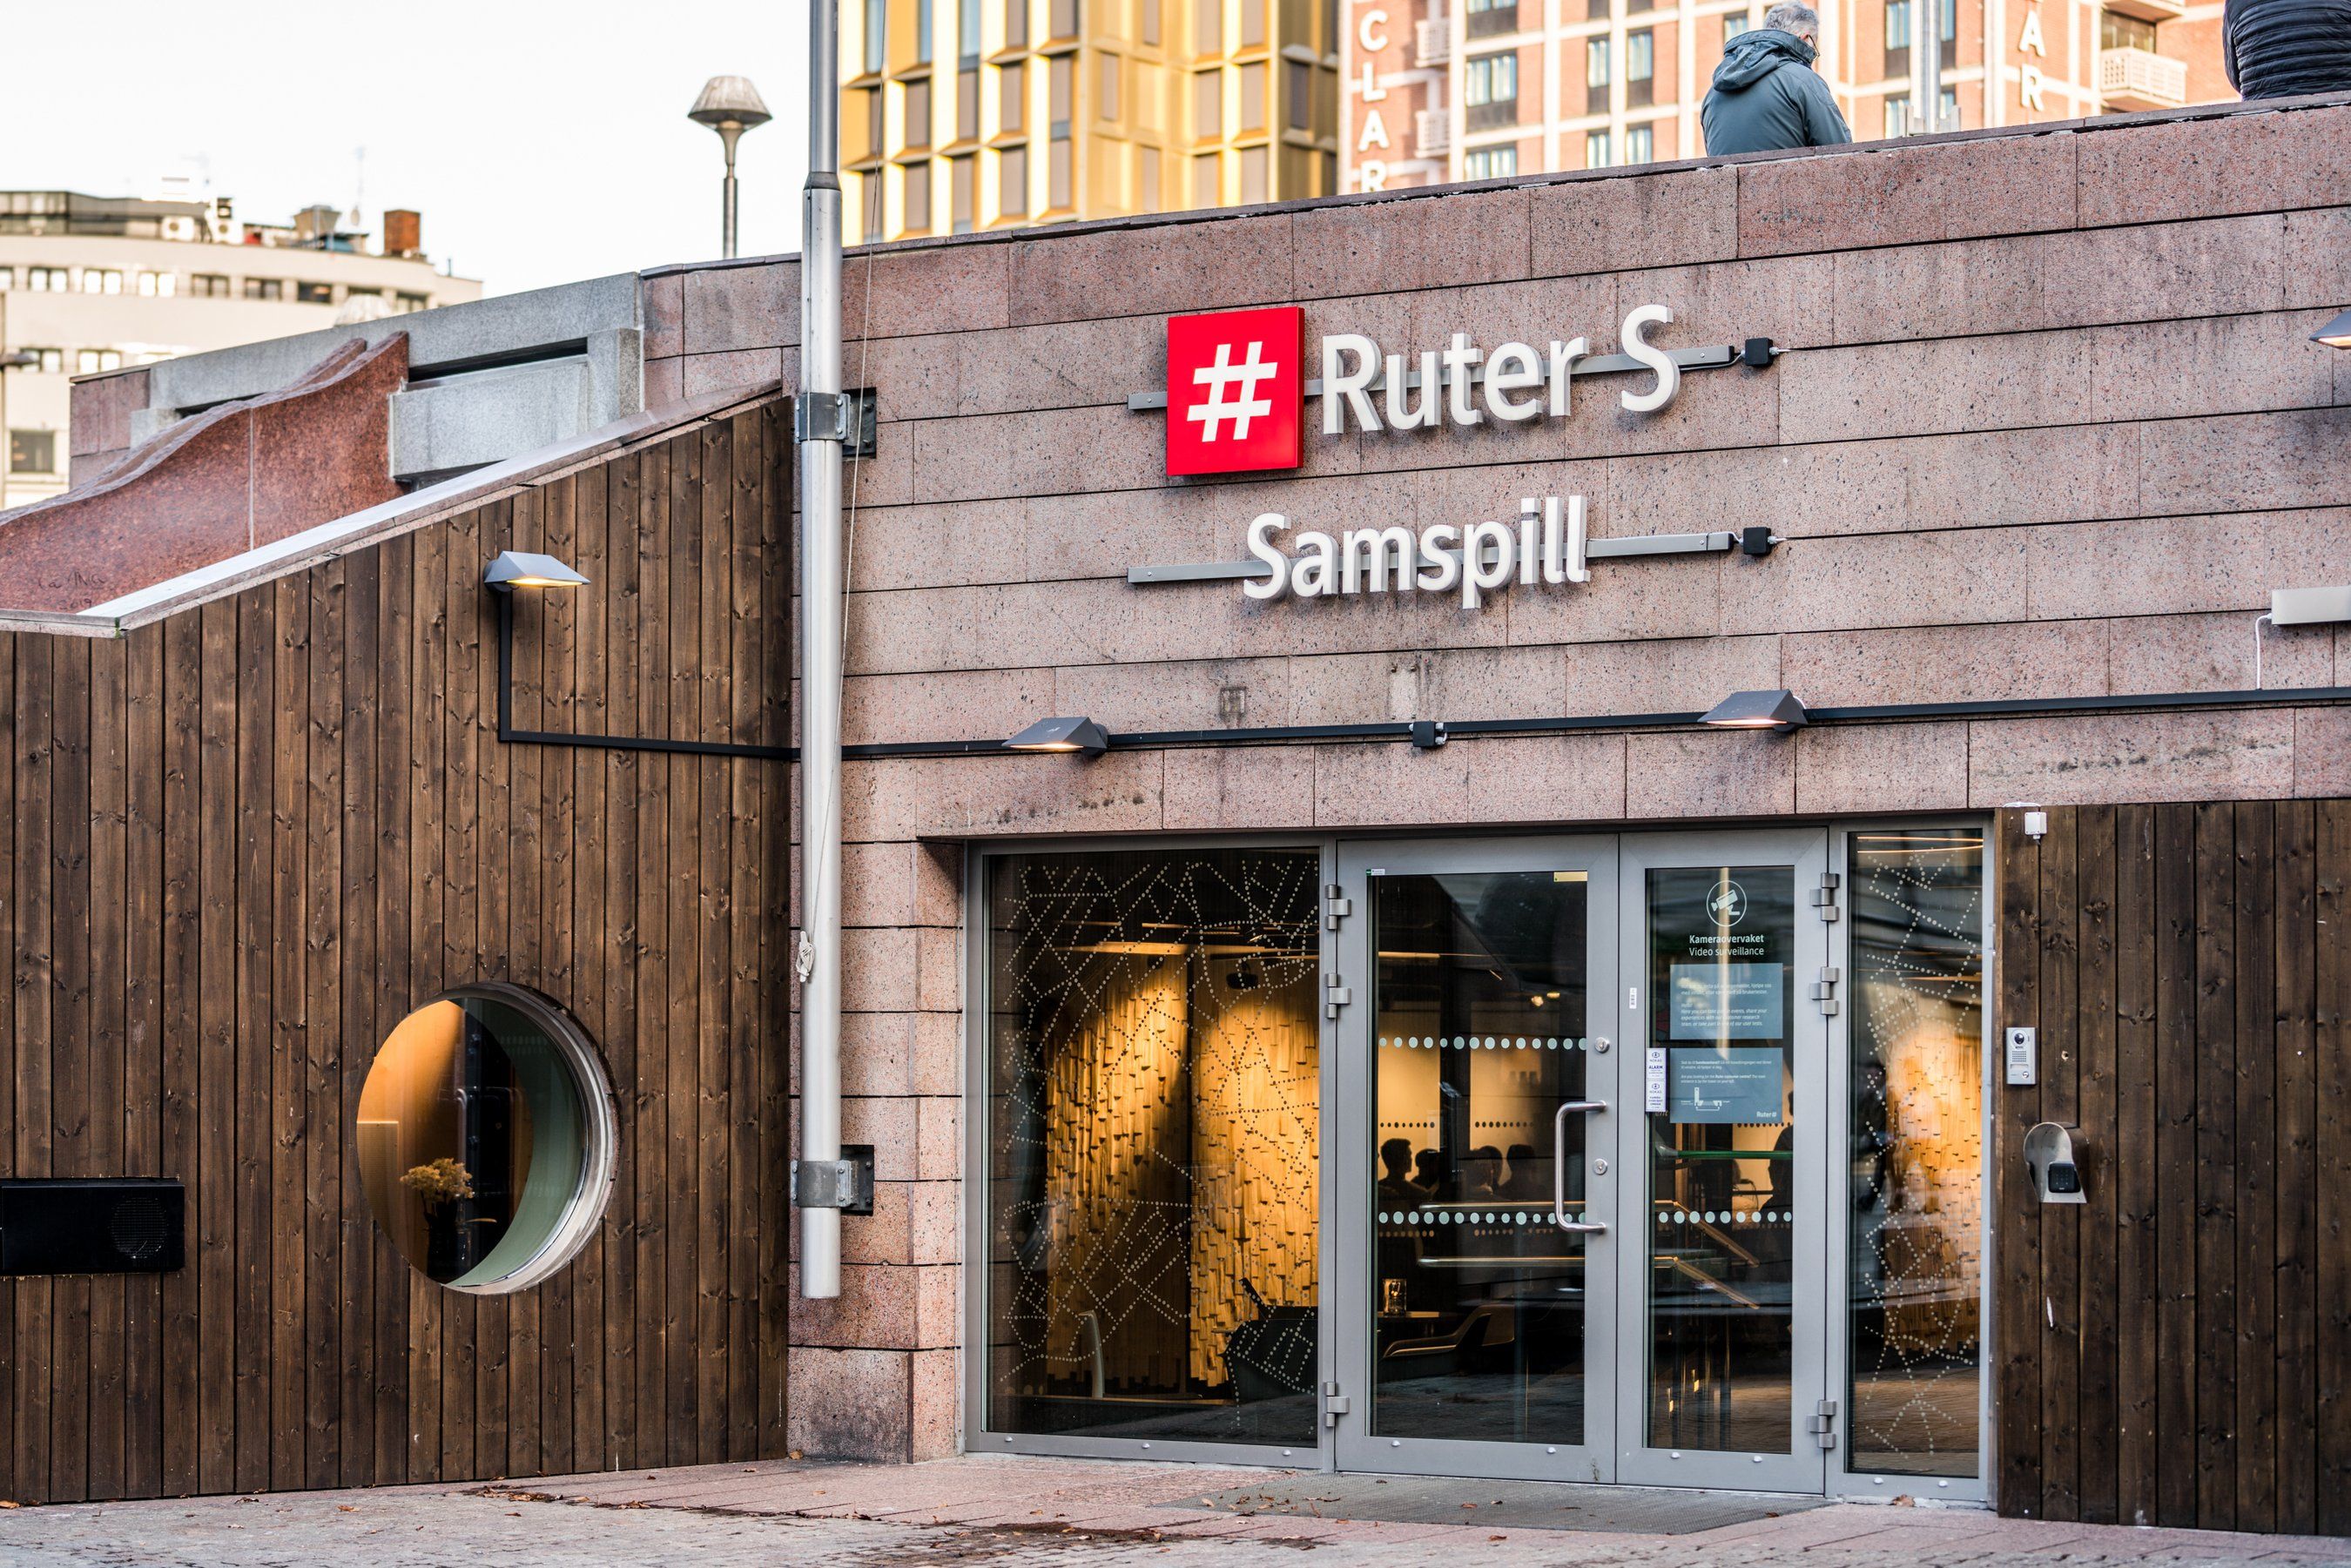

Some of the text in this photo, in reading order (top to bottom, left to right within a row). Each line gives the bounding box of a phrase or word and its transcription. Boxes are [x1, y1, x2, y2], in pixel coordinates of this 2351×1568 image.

[1322, 333, 1590, 435] Ruter
[1620, 304, 1681, 413] S
[1243, 495, 1591, 609] Samspill
[1688, 933, 1765, 944] Kameraovervaket
[1688, 946, 1765, 956] Video surveillance
